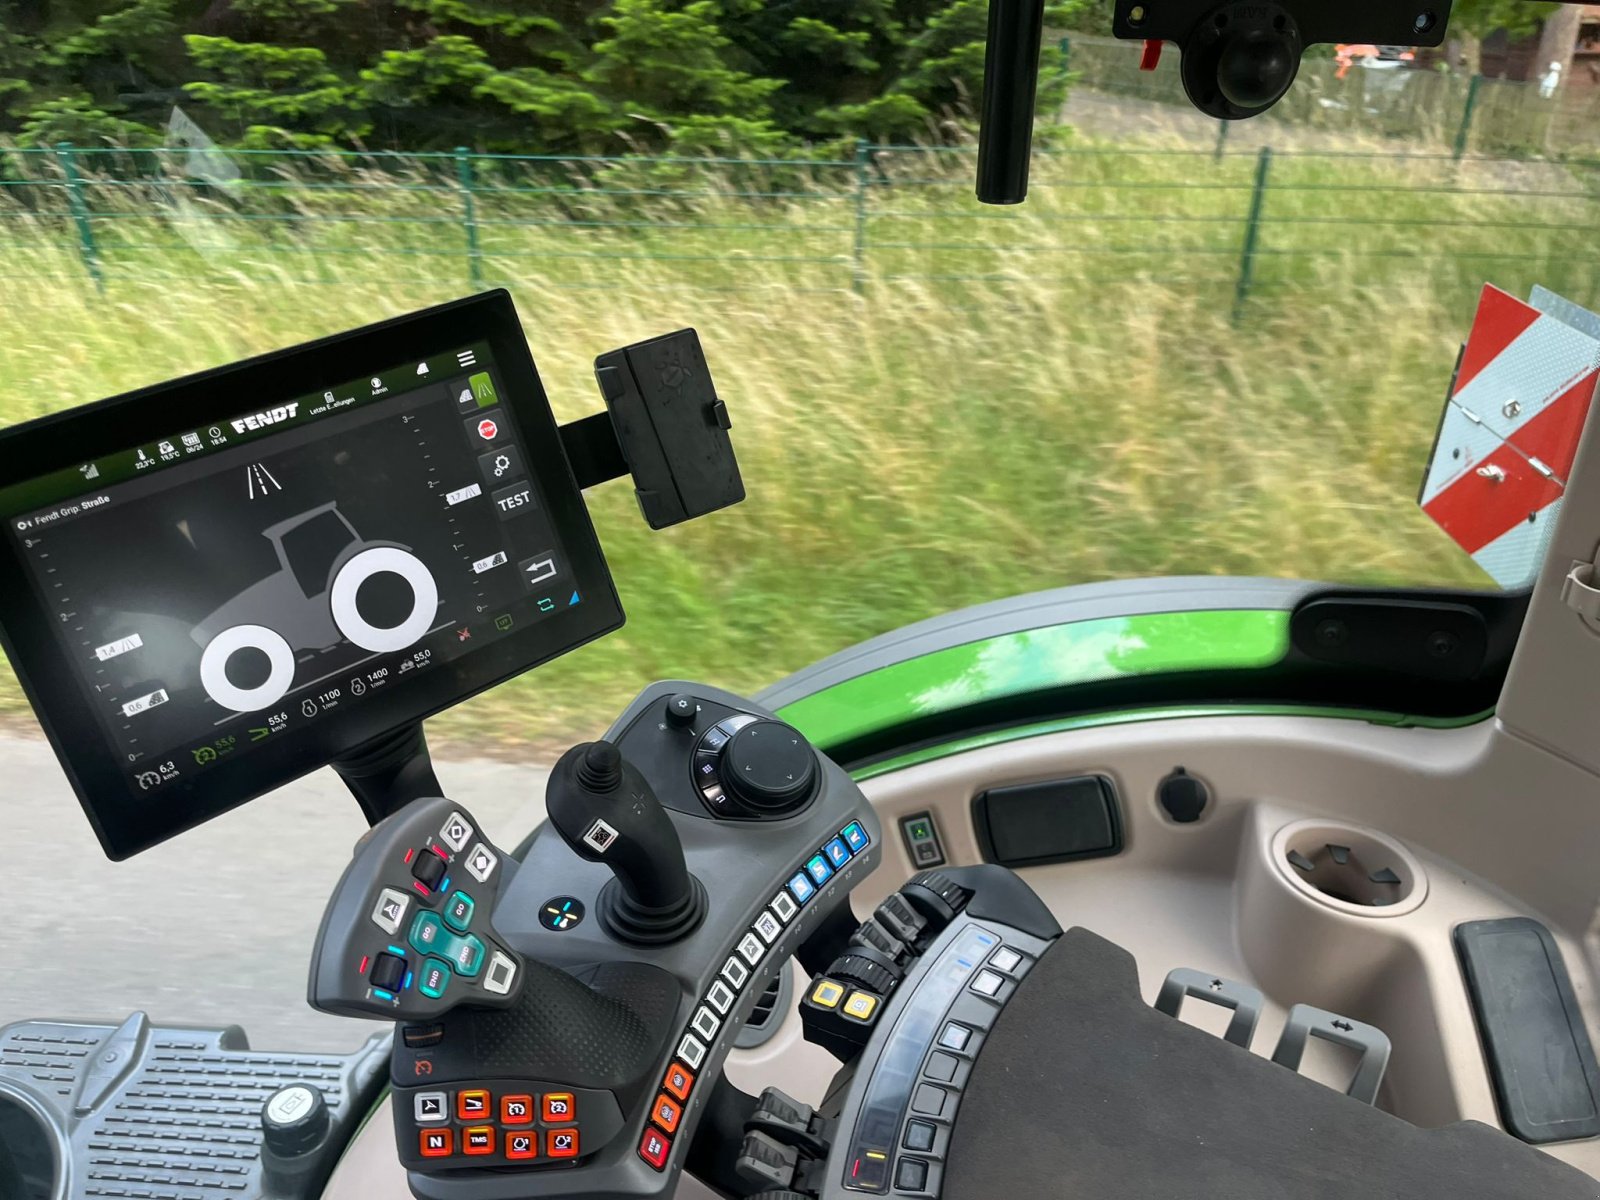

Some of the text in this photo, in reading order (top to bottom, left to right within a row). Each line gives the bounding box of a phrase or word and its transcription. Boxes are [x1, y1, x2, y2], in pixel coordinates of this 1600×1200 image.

[371, 386, 389, 396] Admin
[230, 402, 299, 434] FENDT
[497, 491, 530, 512] TEST
[34, 496, 110, 526] Fendt Grip: Straße
[413, 649, 431, 662] 55,0
[367, 667, 388, 682] 1400
[318, 688, 341, 703] 1100
[128, 702, 143, 713] 0,6
[268, 711, 288, 726] 55,6
[271, 722, 287, 733] km/h
[159, 760, 175, 774] 6,3
[162, 769, 180, 781] km/h
[456, 903, 465, 916] GO
[422, 926, 432, 940] GO
[460, 946, 470, 963] END
[429, 970, 440, 988] END
[430, 1136, 442, 1148] N
[470, 1136, 488, 1144] TMS
